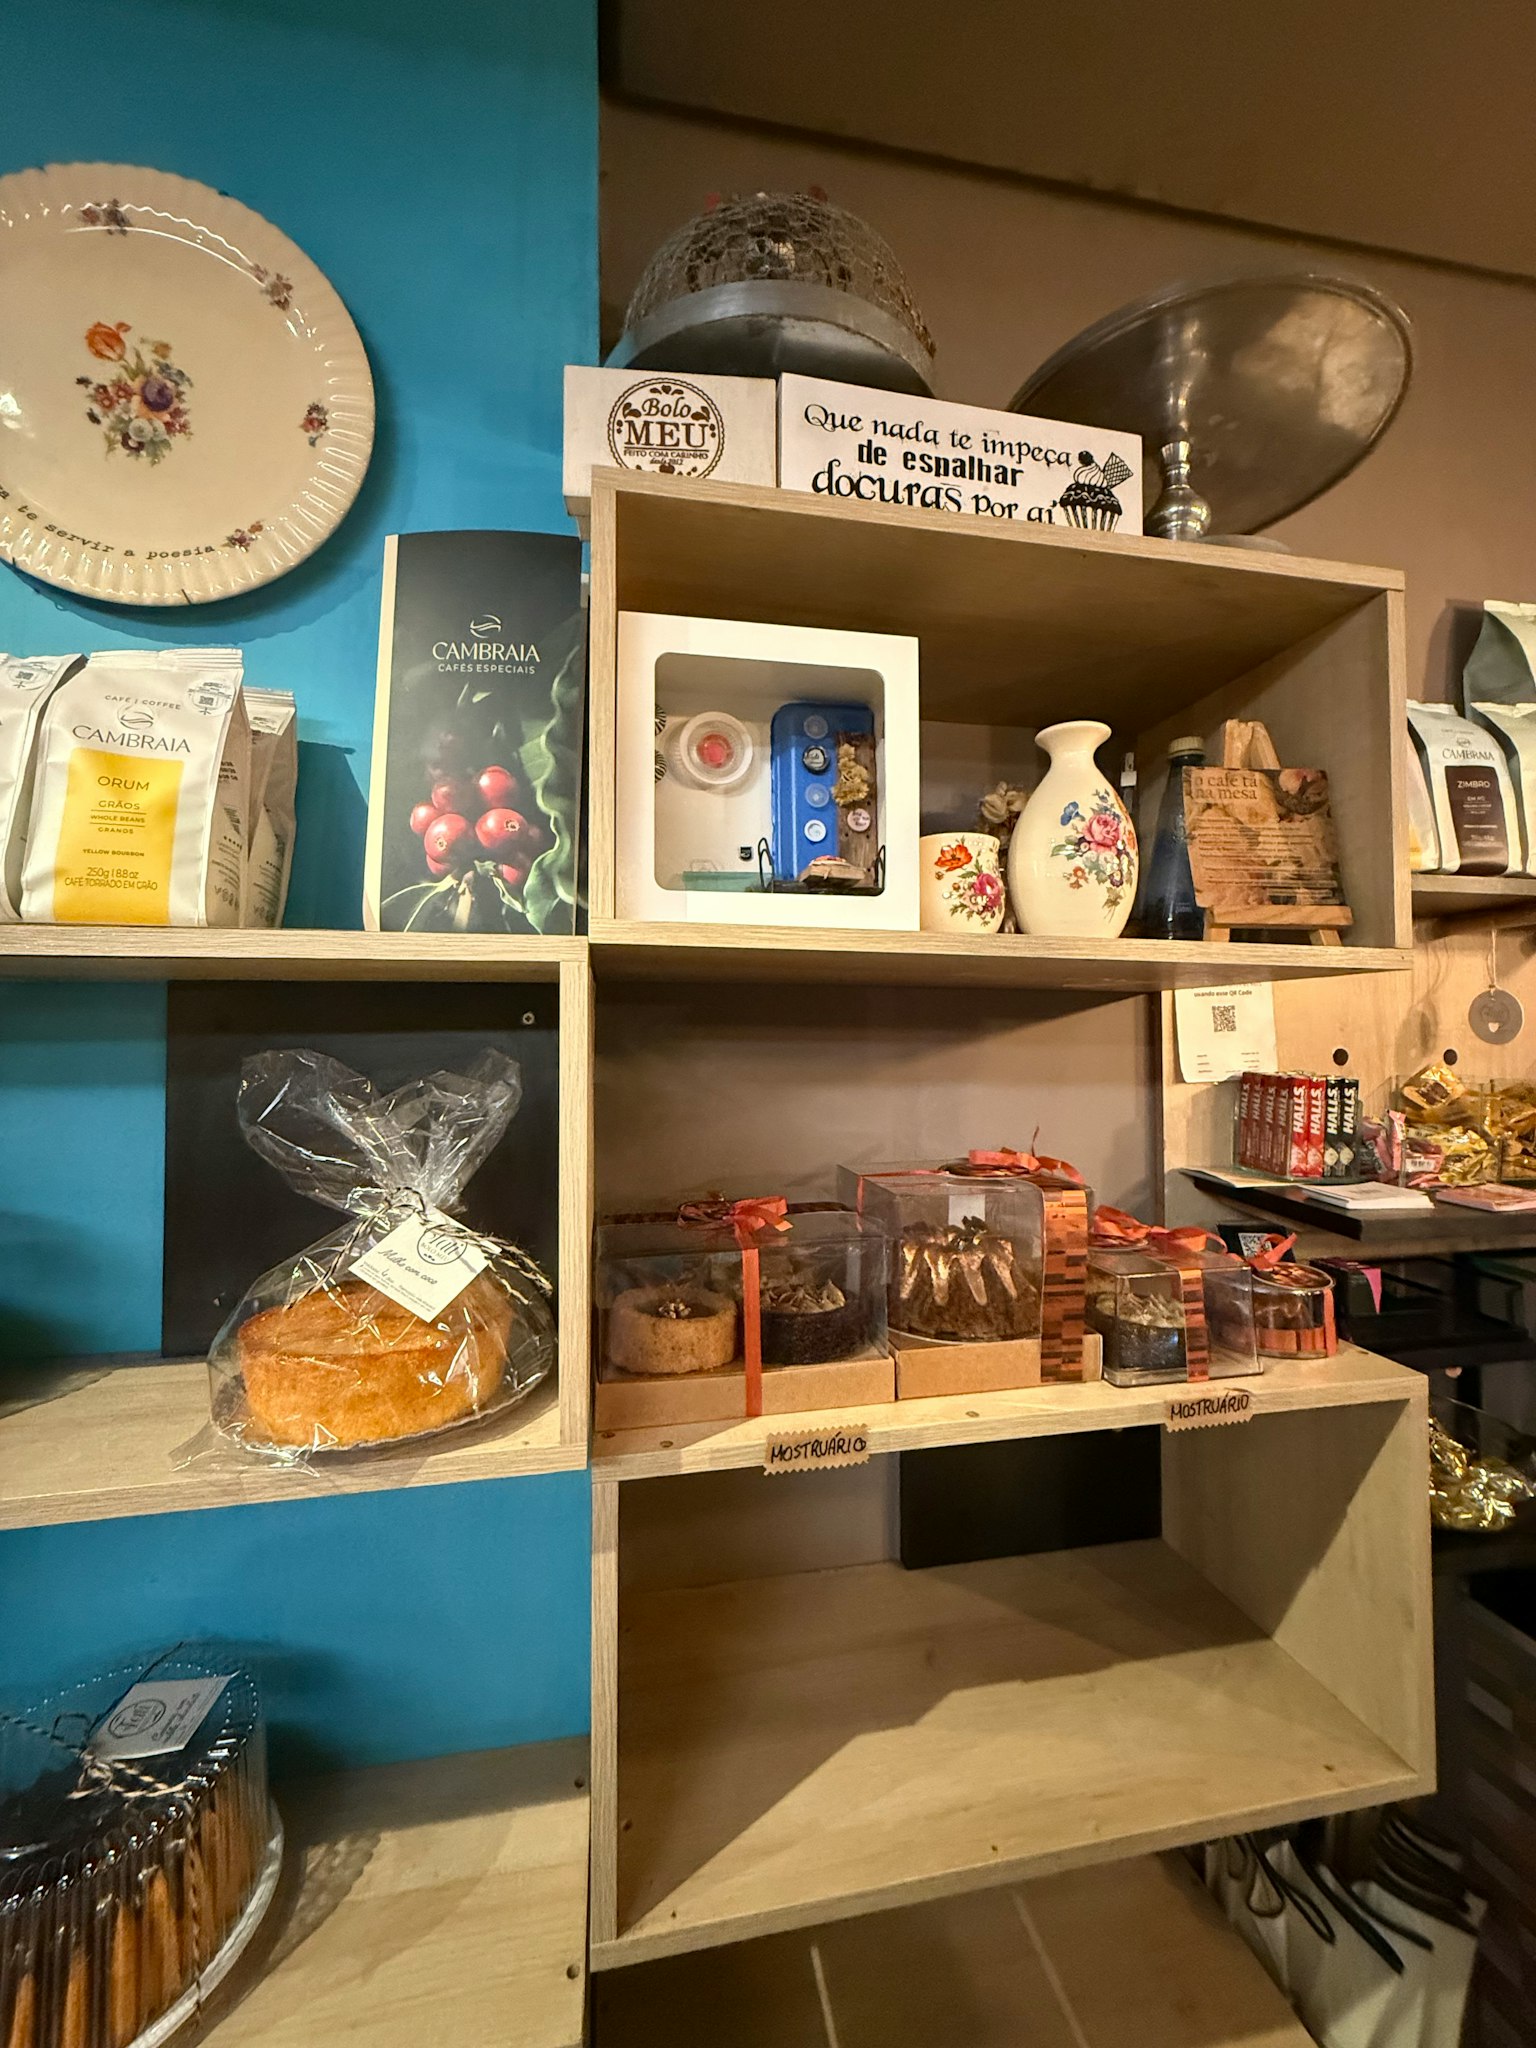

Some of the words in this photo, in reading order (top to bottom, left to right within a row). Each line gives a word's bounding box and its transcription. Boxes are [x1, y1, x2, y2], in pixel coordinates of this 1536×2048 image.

[641, 397, 692, 418] Bolo
[624, 420, 709, 448] MEU
[804, 403, 864, 433] Que
[872, 420, 940, 446] nada
[949, 429, 973, 450] te
[981, 432, 1073, 469] impeça
[623, 449, 647, 457] FEITO
[648, 450, 669, 458] COM
[670, 451, 709, 460] CARINHO
[858, 439, 888, 466] de
[970, 493, 1019, 519] por
[17, 505, 38, 521] te
[44, 523, 115, 553] servir
[123, 549, 135, 557] a
[146, 545, 216, 560] poesia
[432, 641, 541, 663] CAMBRAIA
[476, 663, 536, 675] ESPECIAIS
[142, 699, 182, 710] COFFEE
[72, 724, 191, 753] CAMBRAIA
[1441, 747, 1495, 761] CAMBRAIA
[97, 775, 150, 791] ORUM
[1217, 787, 1258, 800] mesa
[1456, 780, 1491, 789] ZIMBRO
[98, 800, 141, 811] GRÃOS
[90, 814, 118, 822] WHOLE
[119, 815, 146, 824] BEANS
[97, 826, 134, 835] GRANOS
[82, 848, 110, 856] YELLOW
[85, 877, 123, 889] TORRADO
[1292, 1085, 1306, 1134] HALLS
[1309, 1087, 1323, 1135] HALLS
[1326, 1086, 1339, 1135] HALLS
[1342, 1086, 1357, 1135] HALLS
[1170, 1391, 1250, 1421] MOSTRUÁRIO
[770, 1431, 867, 1464] MOSTRUÁRIO
